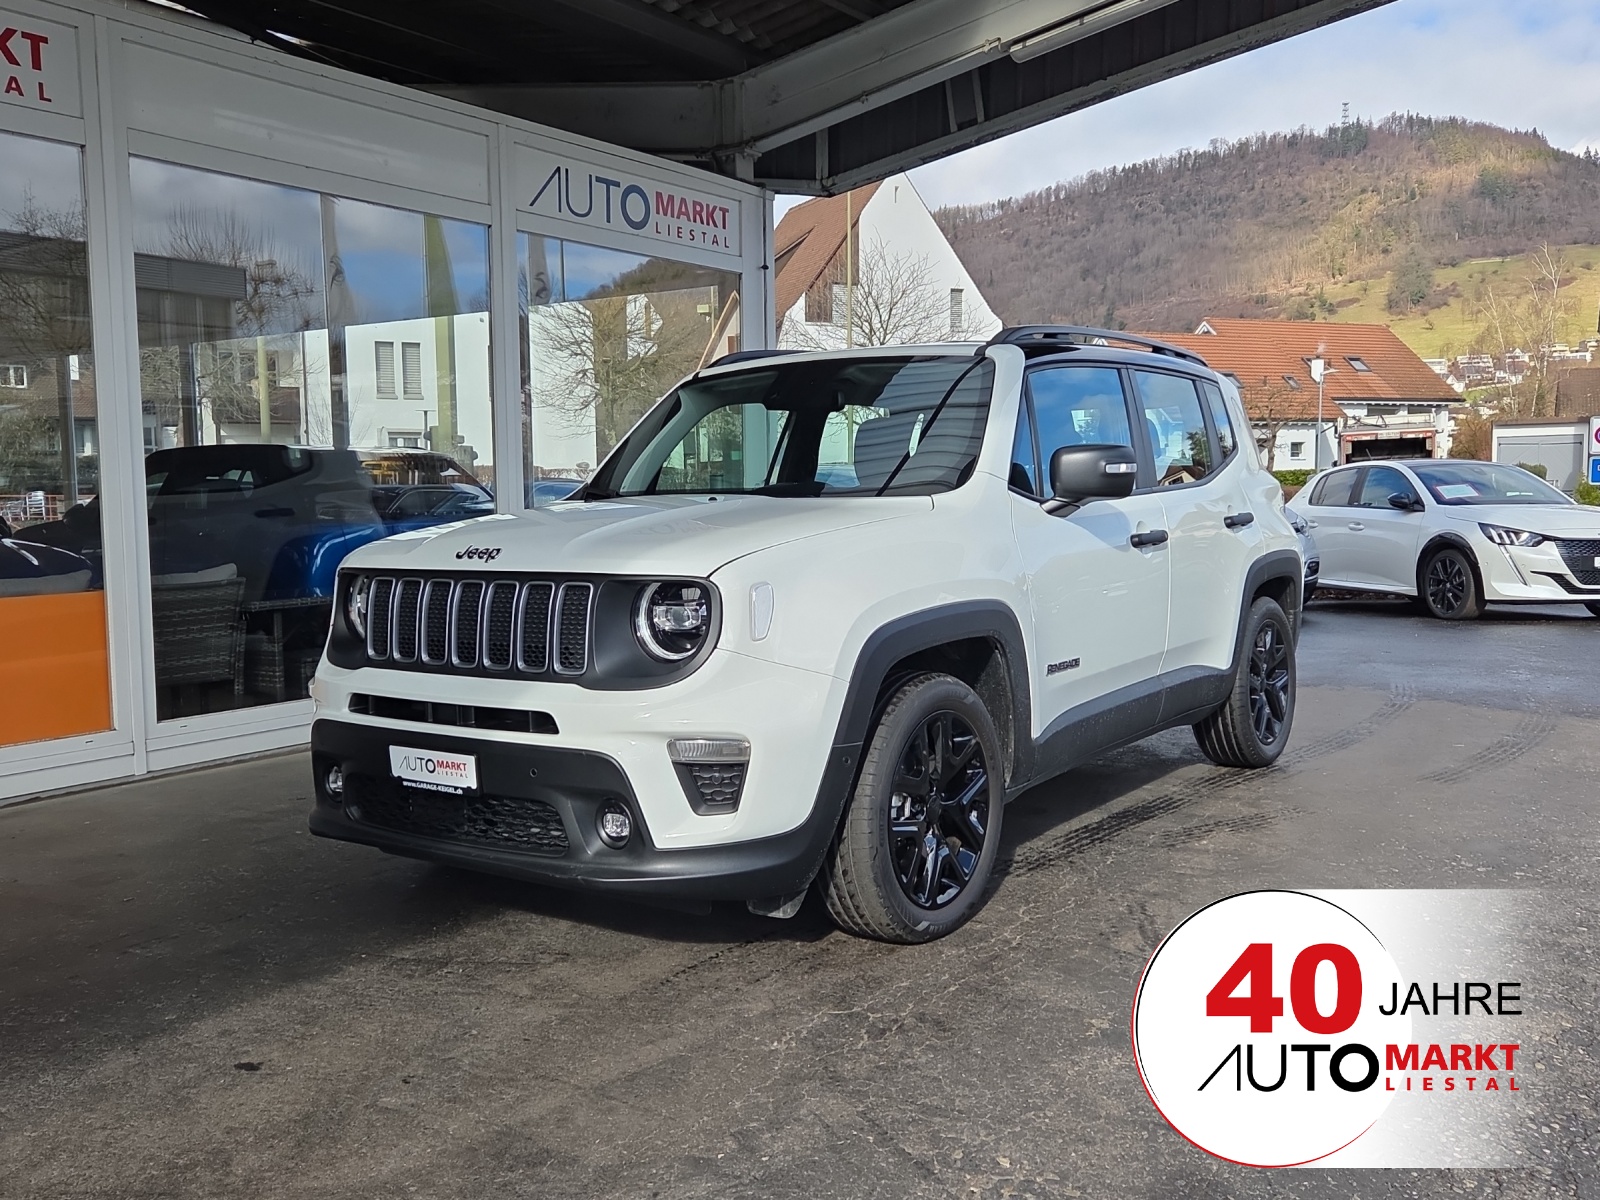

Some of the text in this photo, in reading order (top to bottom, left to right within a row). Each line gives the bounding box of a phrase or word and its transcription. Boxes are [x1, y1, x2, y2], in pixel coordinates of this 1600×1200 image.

[529, 166, 730, 230] AUTO MARKT
[655, 221, 730, 249] LIESTAL
[455, 544, 502, 563] Jeep
[1045, 657, 1081, 677] RENEGADE
[399, 755, 467, 774] AUTO MARKT
[437, 770, 468, 779] LIESTAL
